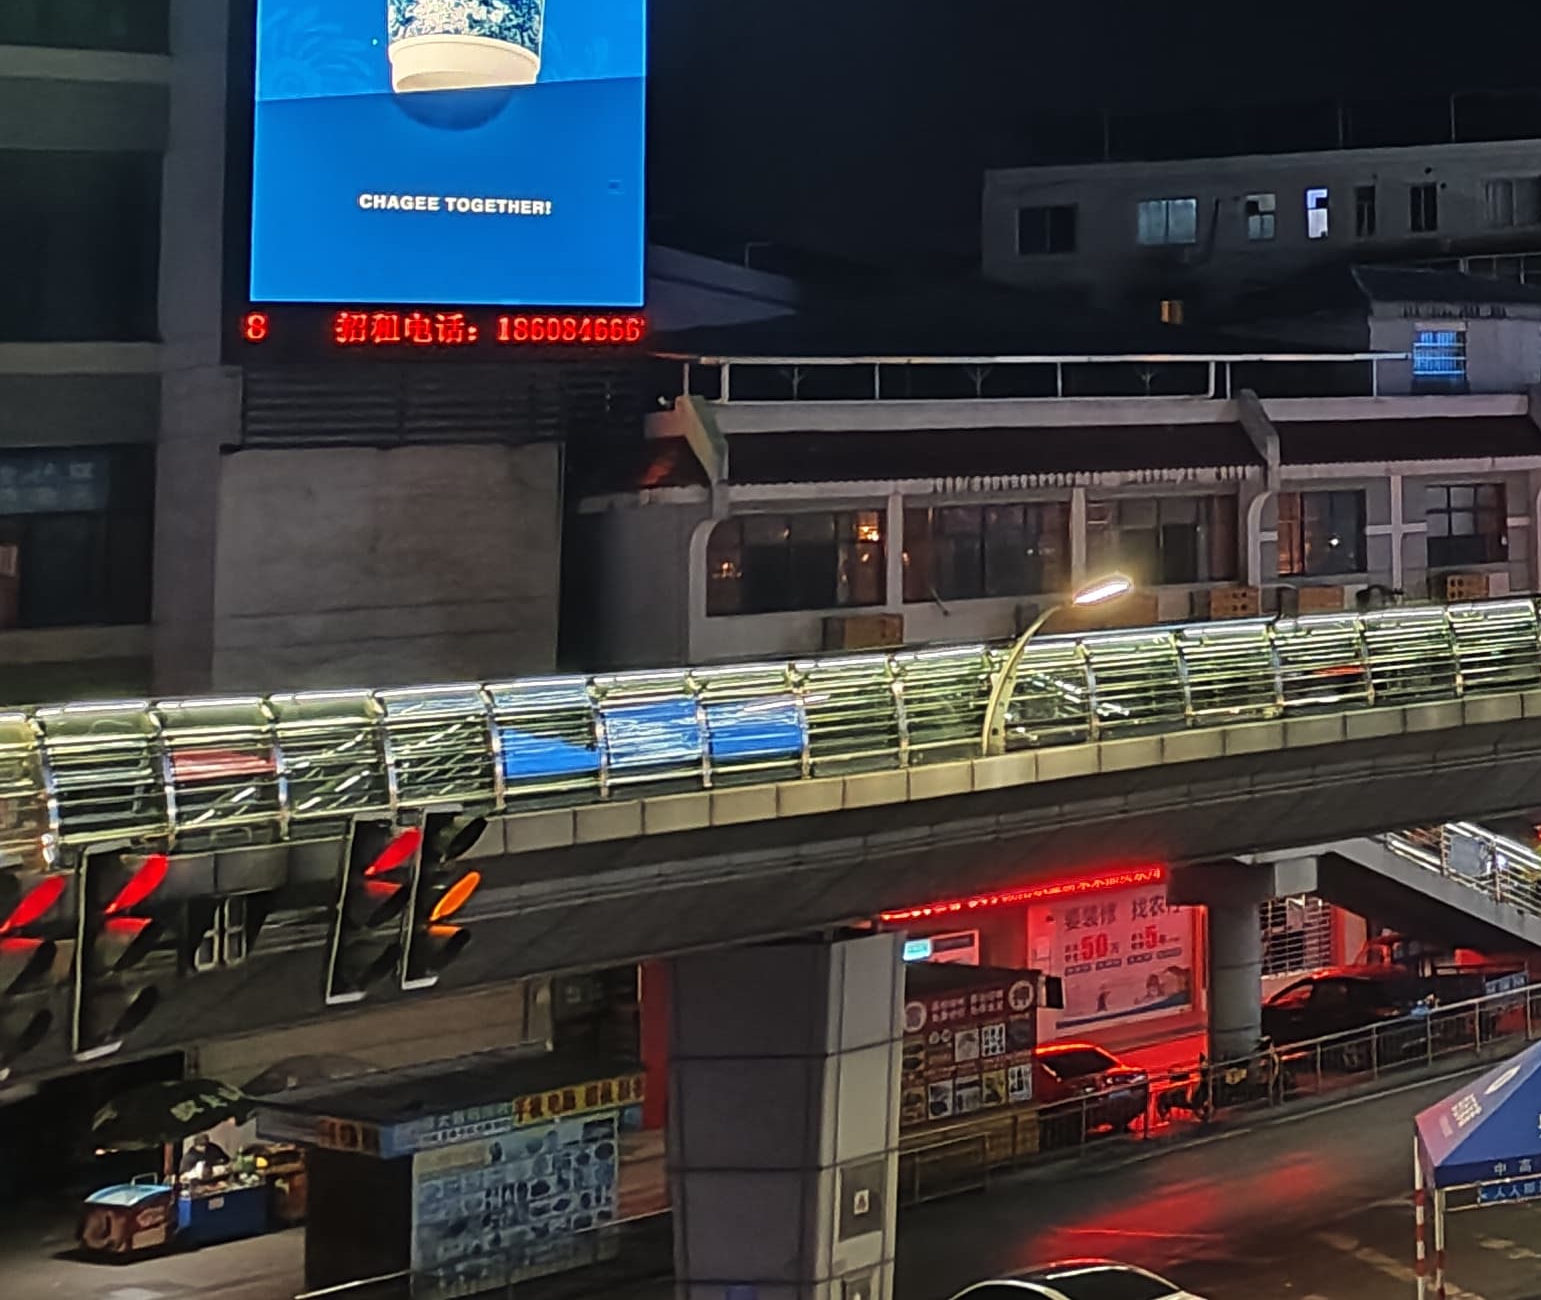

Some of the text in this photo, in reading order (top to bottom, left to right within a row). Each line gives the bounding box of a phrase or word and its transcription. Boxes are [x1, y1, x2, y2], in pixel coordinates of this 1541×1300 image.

[358, 192, 552, 216] CHAGEE TOGETHER!
[497, 314, 646, 342] 186084666
